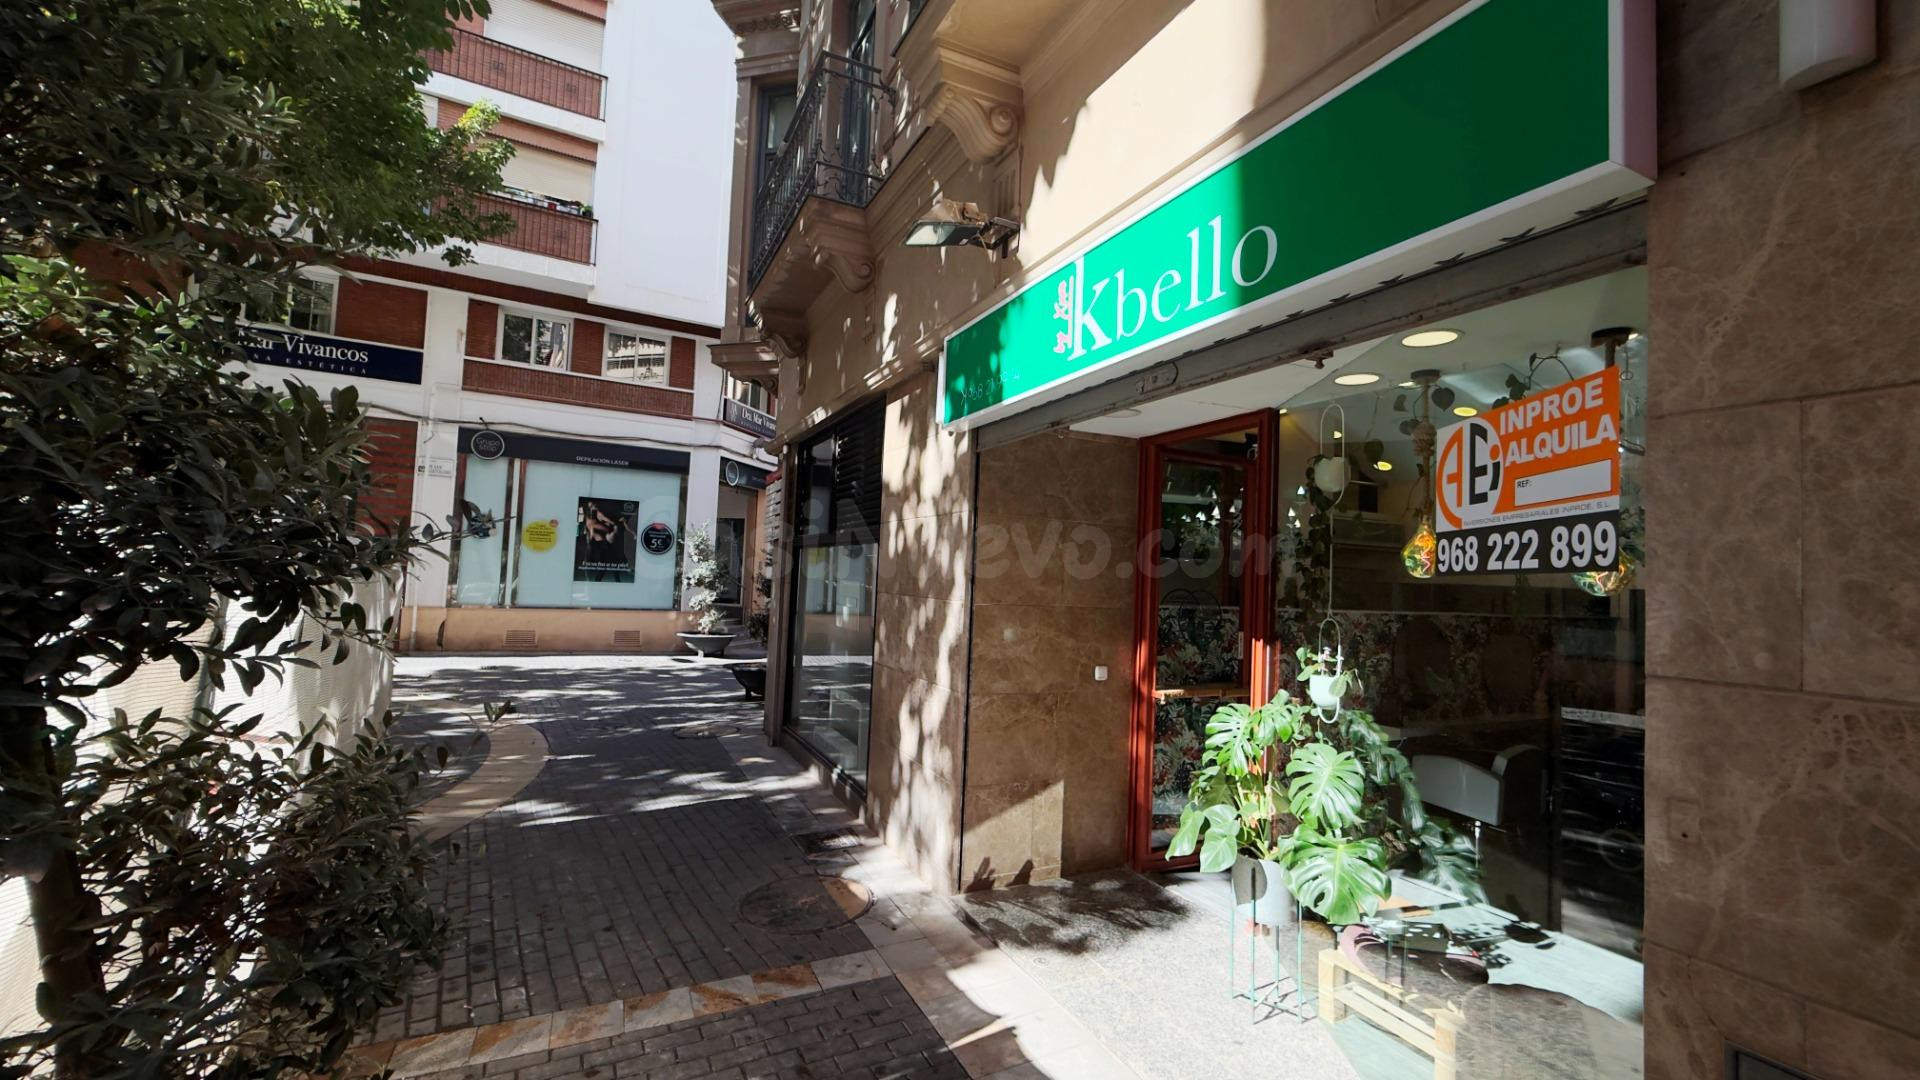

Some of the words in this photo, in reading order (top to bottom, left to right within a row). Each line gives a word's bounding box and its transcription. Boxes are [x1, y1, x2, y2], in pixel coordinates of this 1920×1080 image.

[281, 334, 369, 363] Vivancos
[1500, 377, 1604, 435] INPROE
[1505, 414, 1617, 467] ALQUILA
[1517, 479, 1533, 489] REF:
[1437, 536, 1479, 573] 968
[1487, 529, 1539, 571] 222
[1550, 520, 1617, 570] 899
